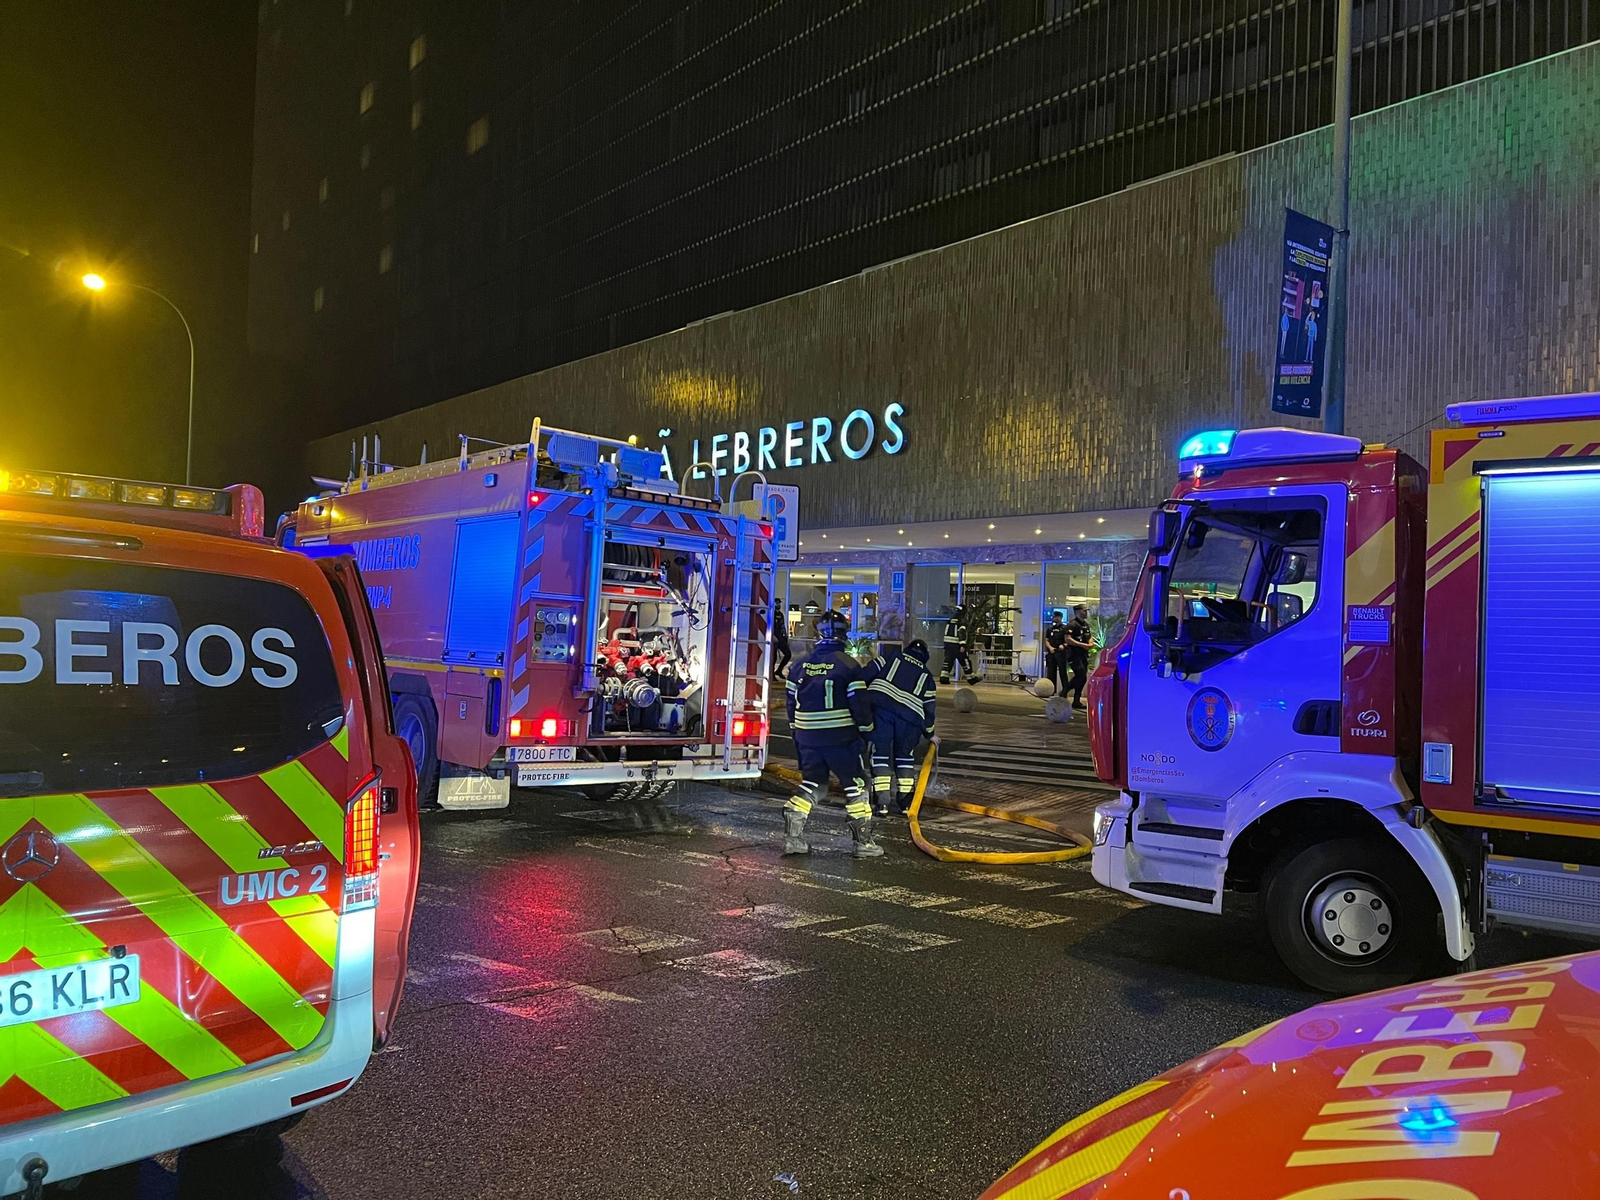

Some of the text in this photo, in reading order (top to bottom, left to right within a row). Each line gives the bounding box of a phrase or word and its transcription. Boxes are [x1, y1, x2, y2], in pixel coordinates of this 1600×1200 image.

[692, 402, 905, 480] LEBREROS
[1352, 607, 1385, 615] RENAULT
[0, 616, 299, 689] BEROS
[517, 748, 571, 760] 7800 FTC
[521, 773, 570, 781] PROTEC-FIRE
[447, 794, 503, 802] PROTEC-FIRE
[221, 868, 300, 905] UMC
[308, 865, 327, 893] 2
[0, 963, 130, 1016] 6 KLR
